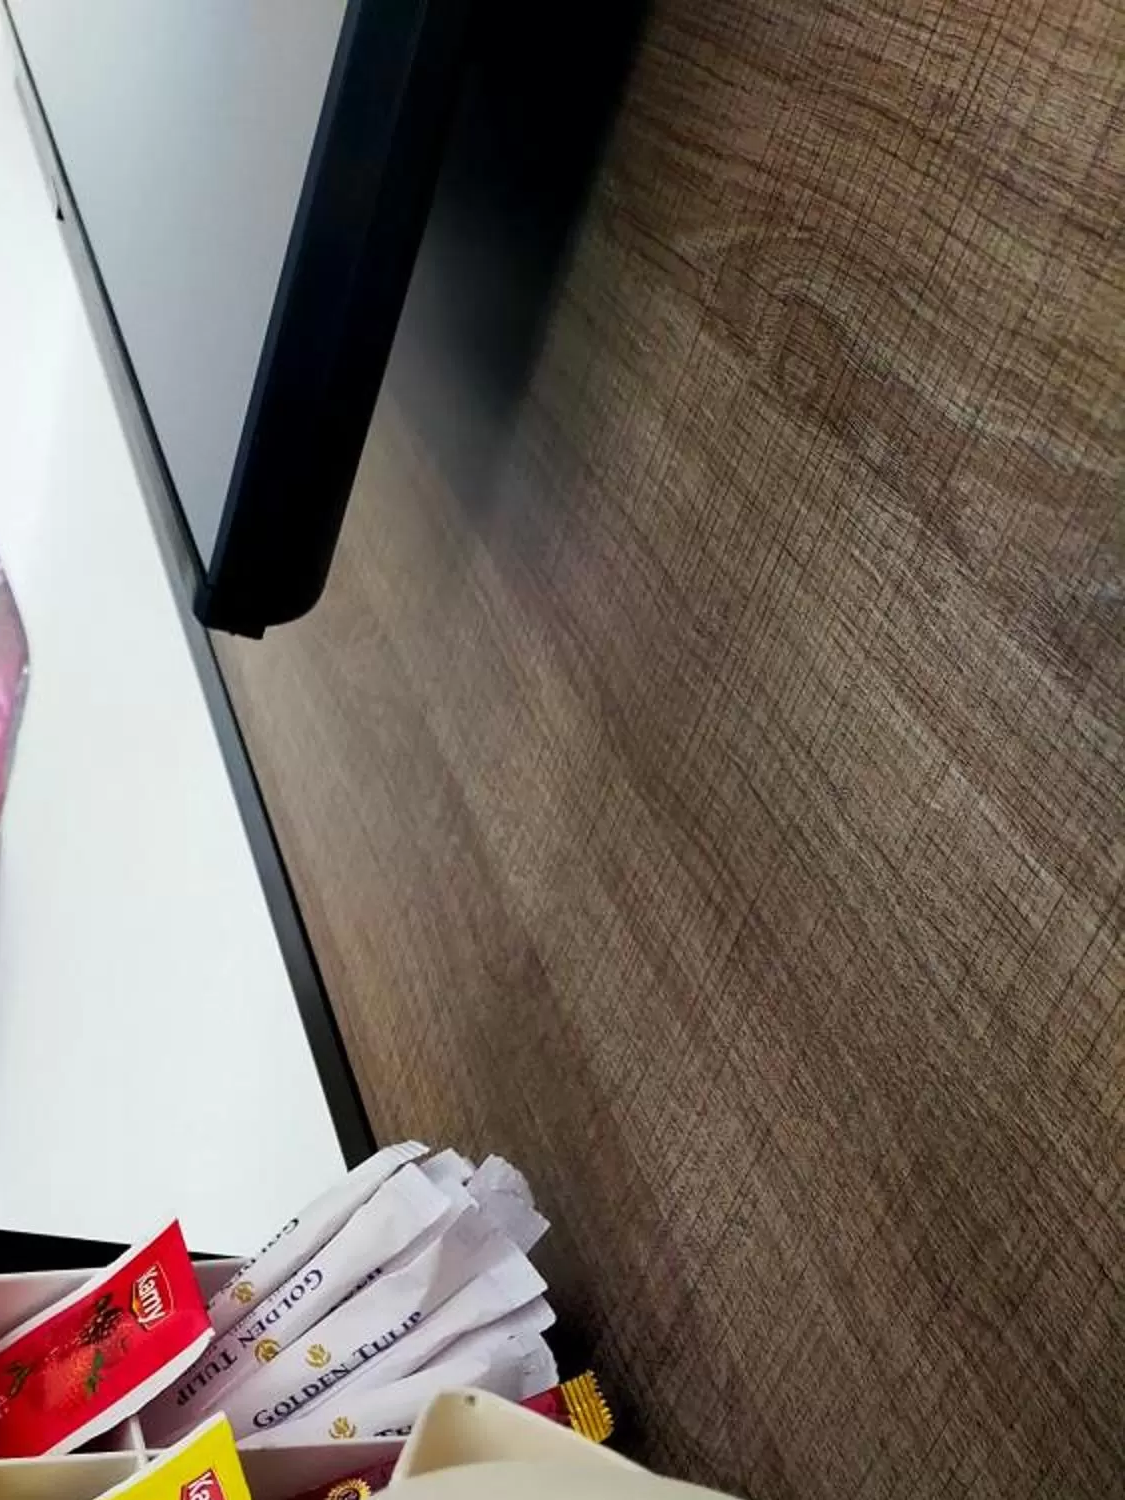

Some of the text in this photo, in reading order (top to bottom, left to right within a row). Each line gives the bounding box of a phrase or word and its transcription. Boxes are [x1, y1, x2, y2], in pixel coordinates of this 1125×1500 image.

[136, 1265, 165, 1327] Kamy
[238, 1268, 324, 1348] GOLDEN
[176, 1348, 238, 1407] TULIP
[252, 1311, 423, 1429] GOLDEN TULIP
